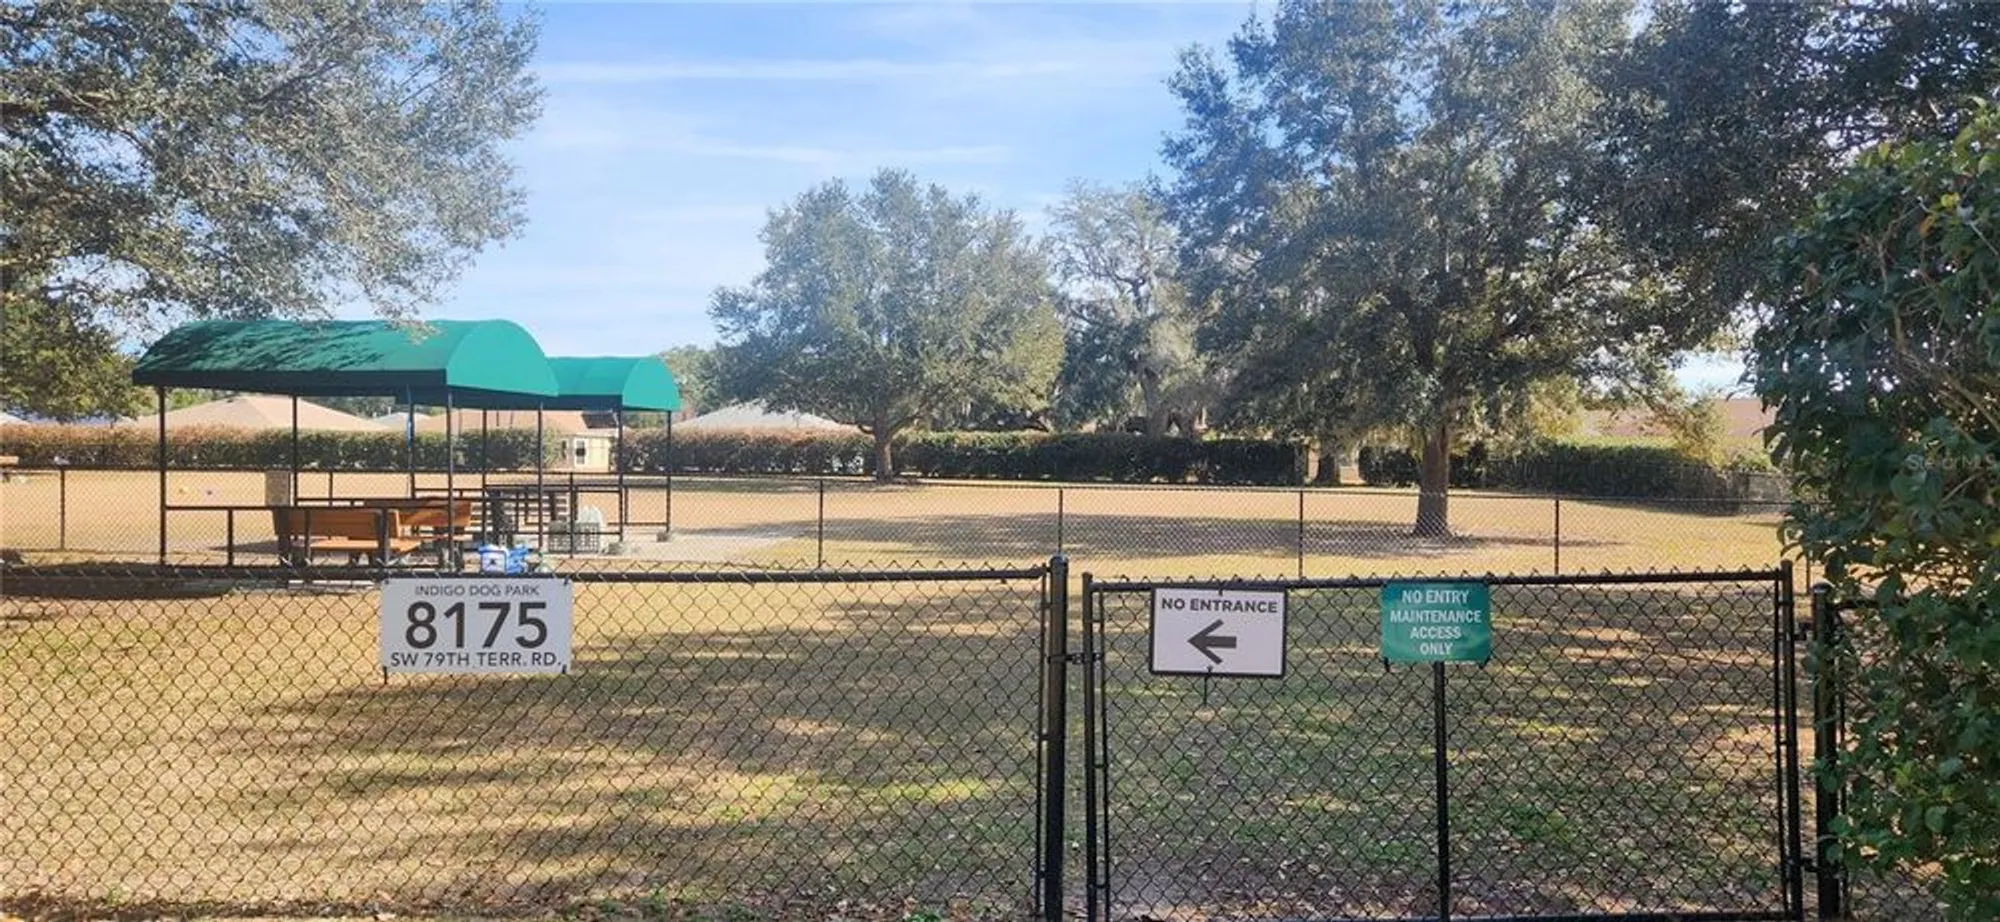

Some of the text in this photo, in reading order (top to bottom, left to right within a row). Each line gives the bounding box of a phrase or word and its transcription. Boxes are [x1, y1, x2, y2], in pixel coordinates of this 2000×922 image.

[415, 584, 540, 597] INDIGO DOG PARK
[1402, 590, 1469, 604] NO ENTRY
[1161, 598, 1278, 613] NO ENTRANCE
[1390, 610, 1482, 623] MAINTENANCE
[405, 601, 548, 649] 8175
[1410, 626, 1461, 639] ACCESS
[1420, 642, 1453, 655] ONLY
[391, 652, 562, 667] SW 79TH TERR. RD.
